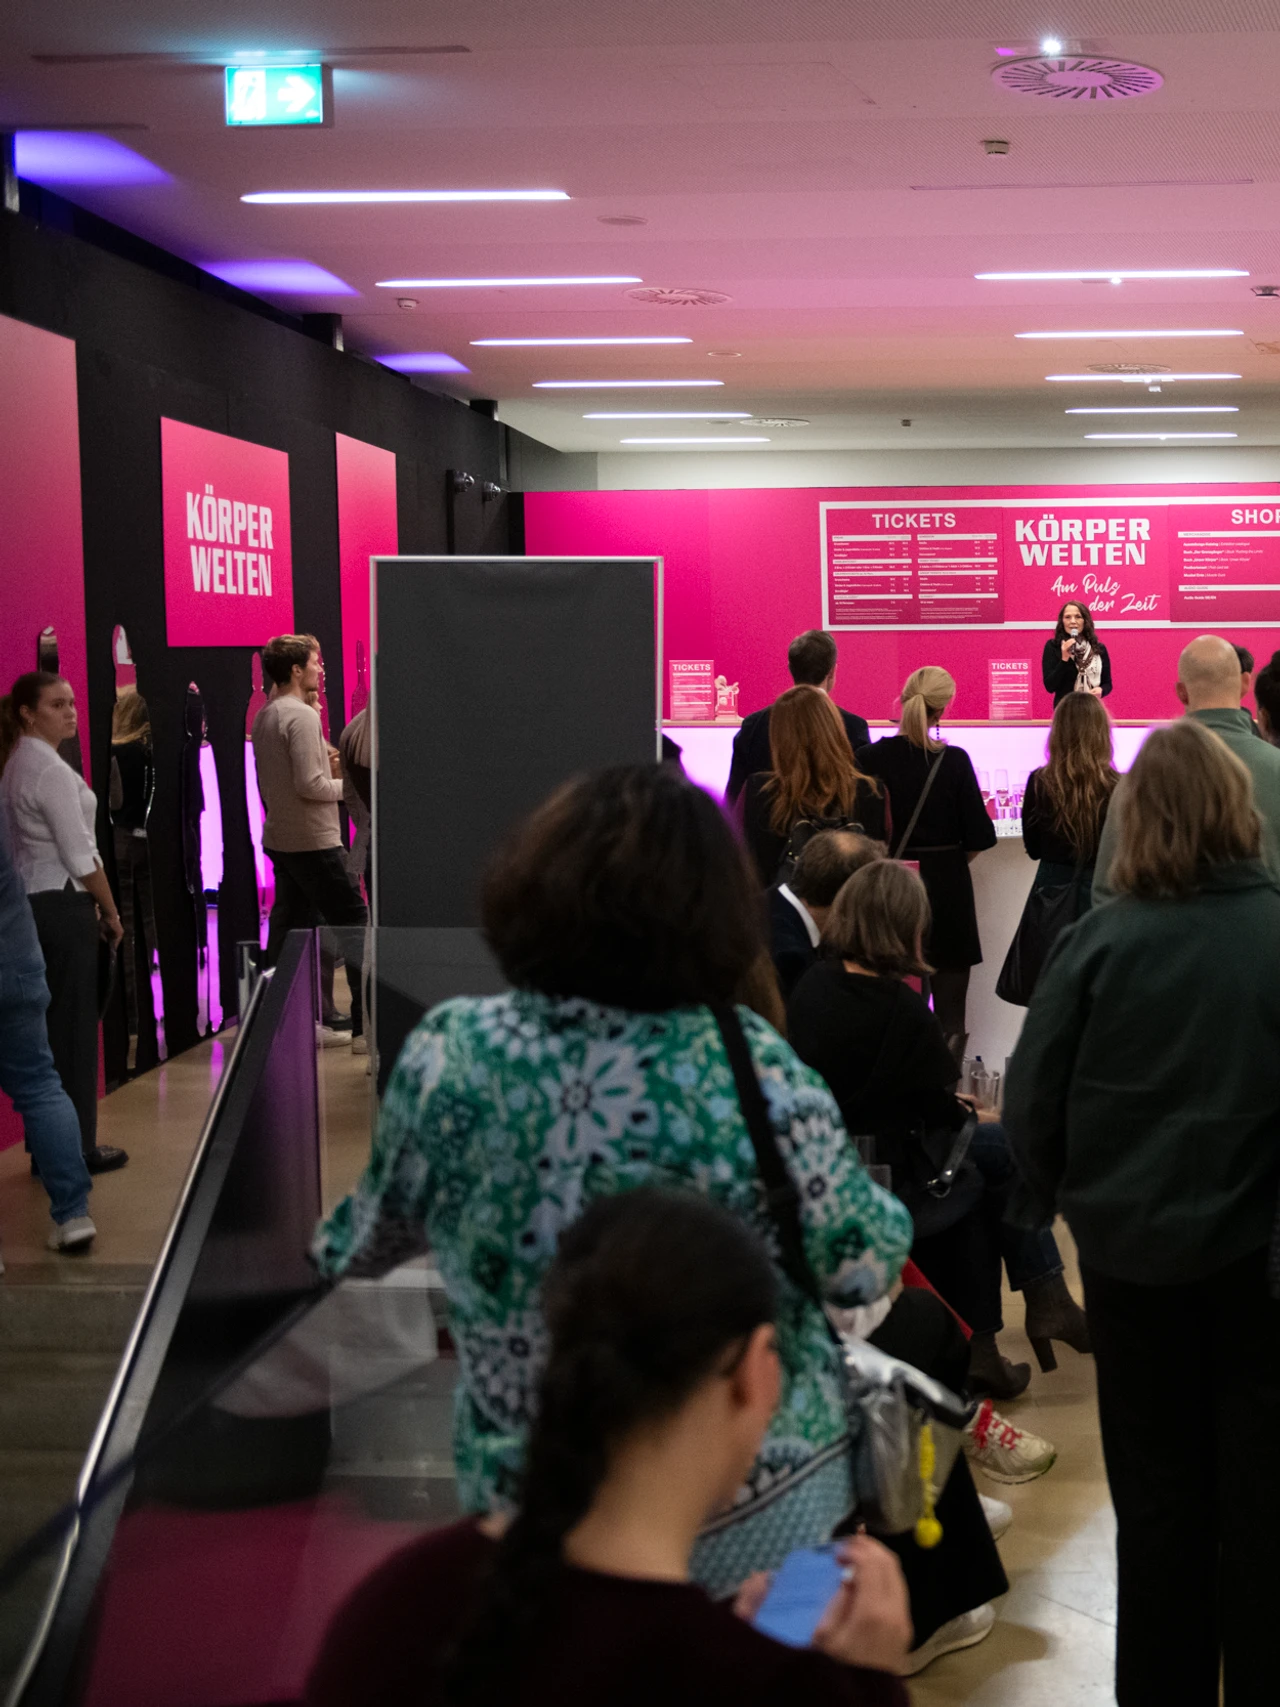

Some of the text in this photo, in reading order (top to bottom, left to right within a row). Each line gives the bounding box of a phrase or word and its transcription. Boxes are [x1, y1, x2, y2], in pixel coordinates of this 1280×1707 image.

[186, 483, 274, 549] KÖRPER
[872, 513, 956, 528] TICKETS
[1015, 514, 1151, 542] KÖRPER
[1019, 543, 1146, 566] WELTEN
[190, 545, 273, 597] WELTEN
[1050, 573, 1121, 597] Am Puls
[1088, 593, 1161, 613] der Zeit
[991, 662, 1029, 670] TICKETS
